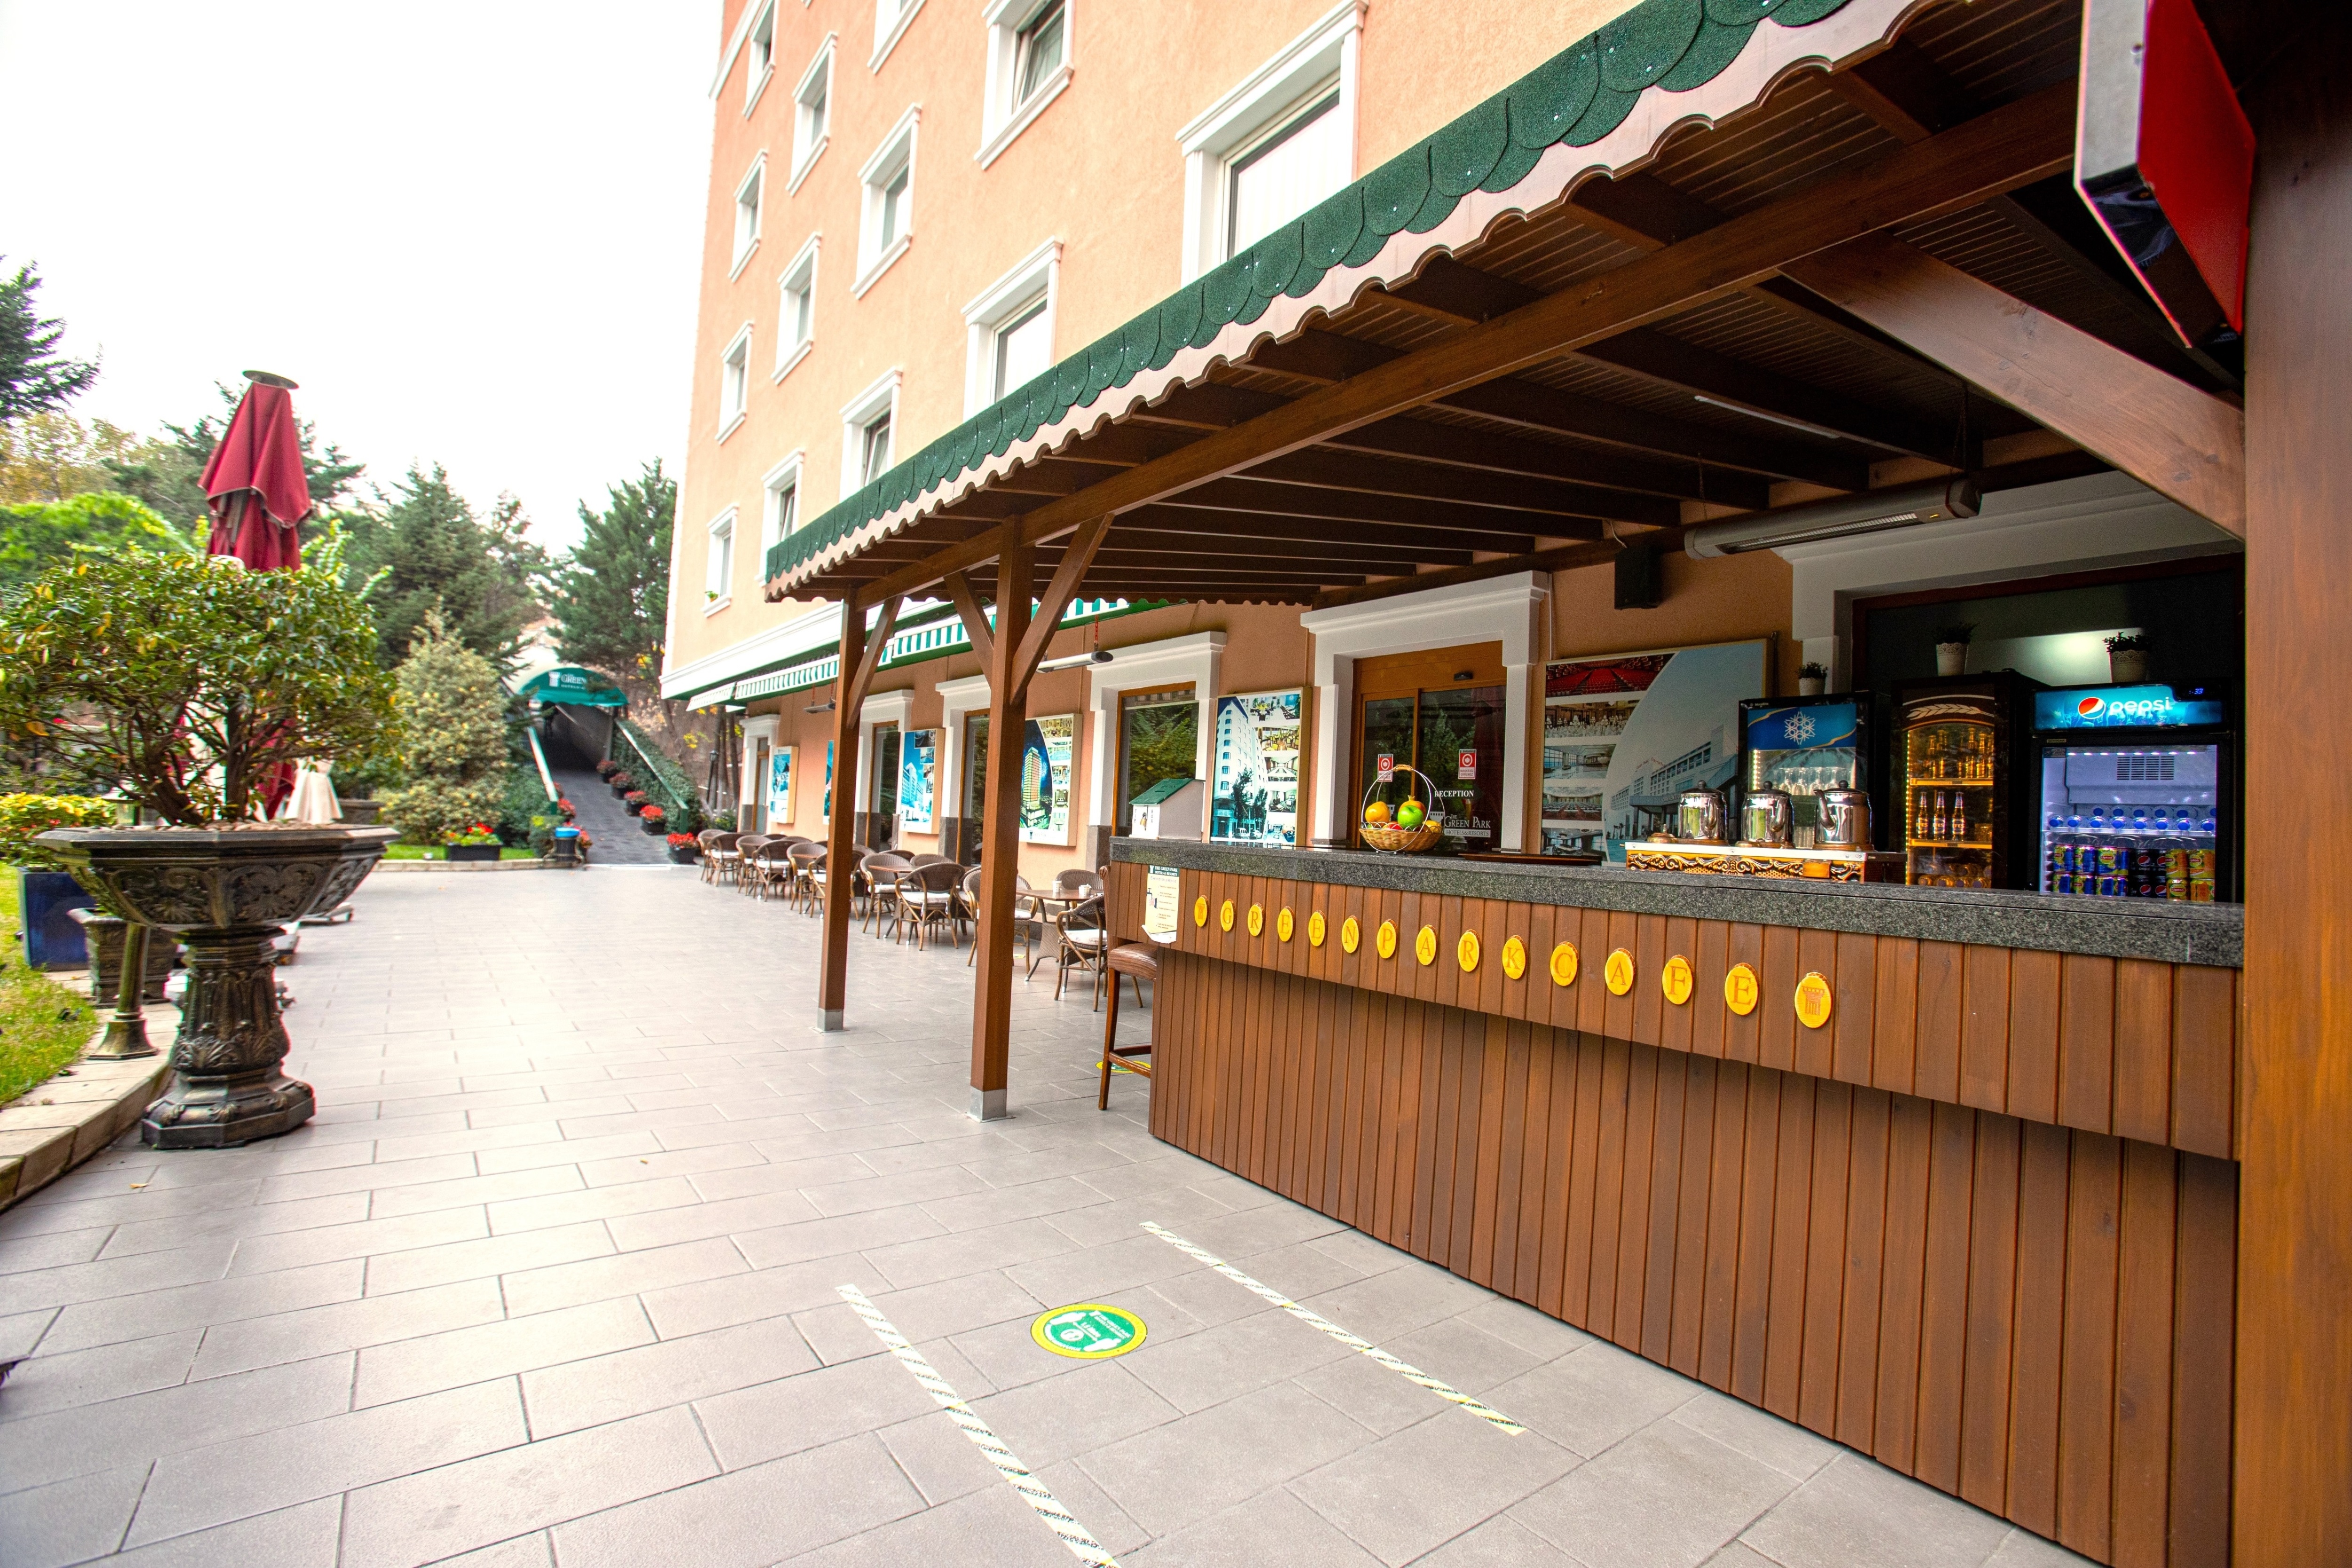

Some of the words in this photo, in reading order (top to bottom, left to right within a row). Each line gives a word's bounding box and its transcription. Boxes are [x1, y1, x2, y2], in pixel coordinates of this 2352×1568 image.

[2109, 696, 2170, 716] pepsi
[1445, 816, 1470, 828] GREEN
[1472, 816, 1491, 828] PARK
